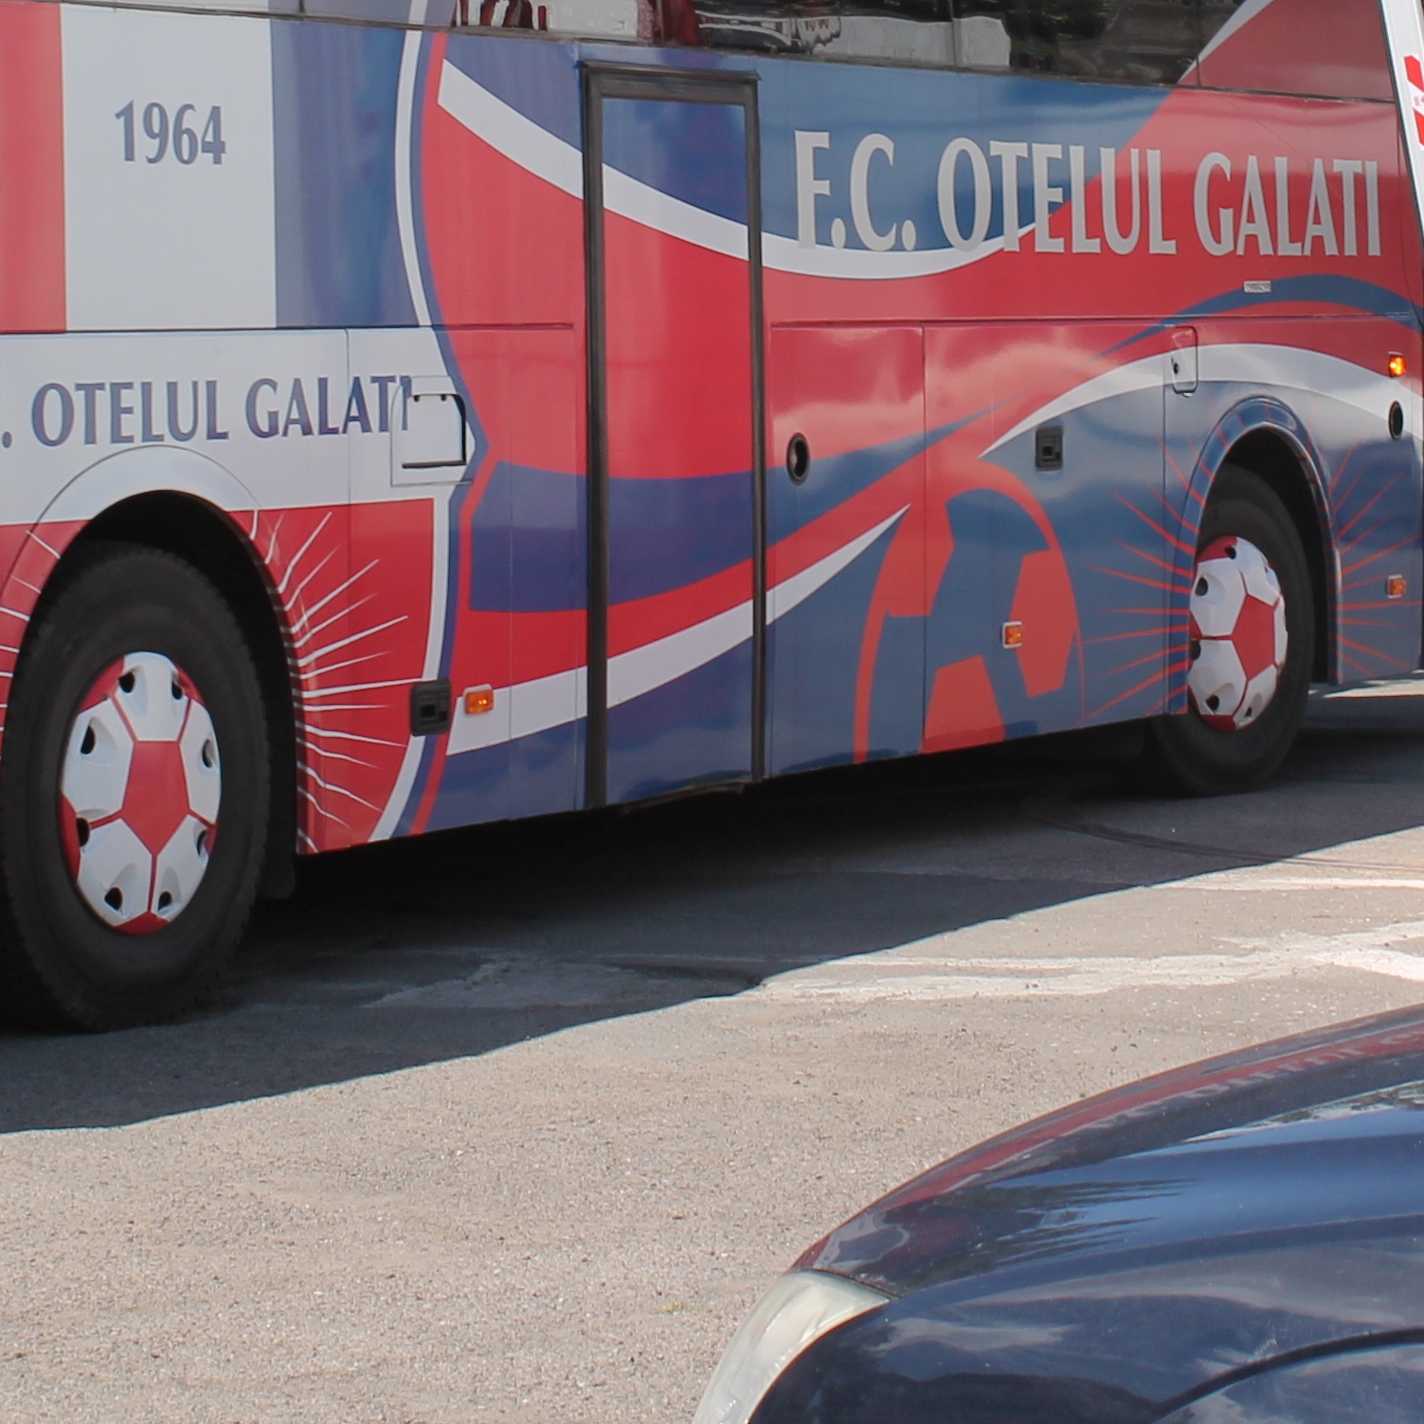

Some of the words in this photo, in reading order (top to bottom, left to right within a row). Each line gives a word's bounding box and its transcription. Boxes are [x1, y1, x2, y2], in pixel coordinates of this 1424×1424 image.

[115, 100, 226, 165] 1964
[795, 130, 917, 251] F.C.
[937, 137, 1176, 255] OTELUL
[1193, 151, 1381, 257] GALATI
[31, 380, 230, 448] OTELUL
[245, 375, 412, 439] GALATI
